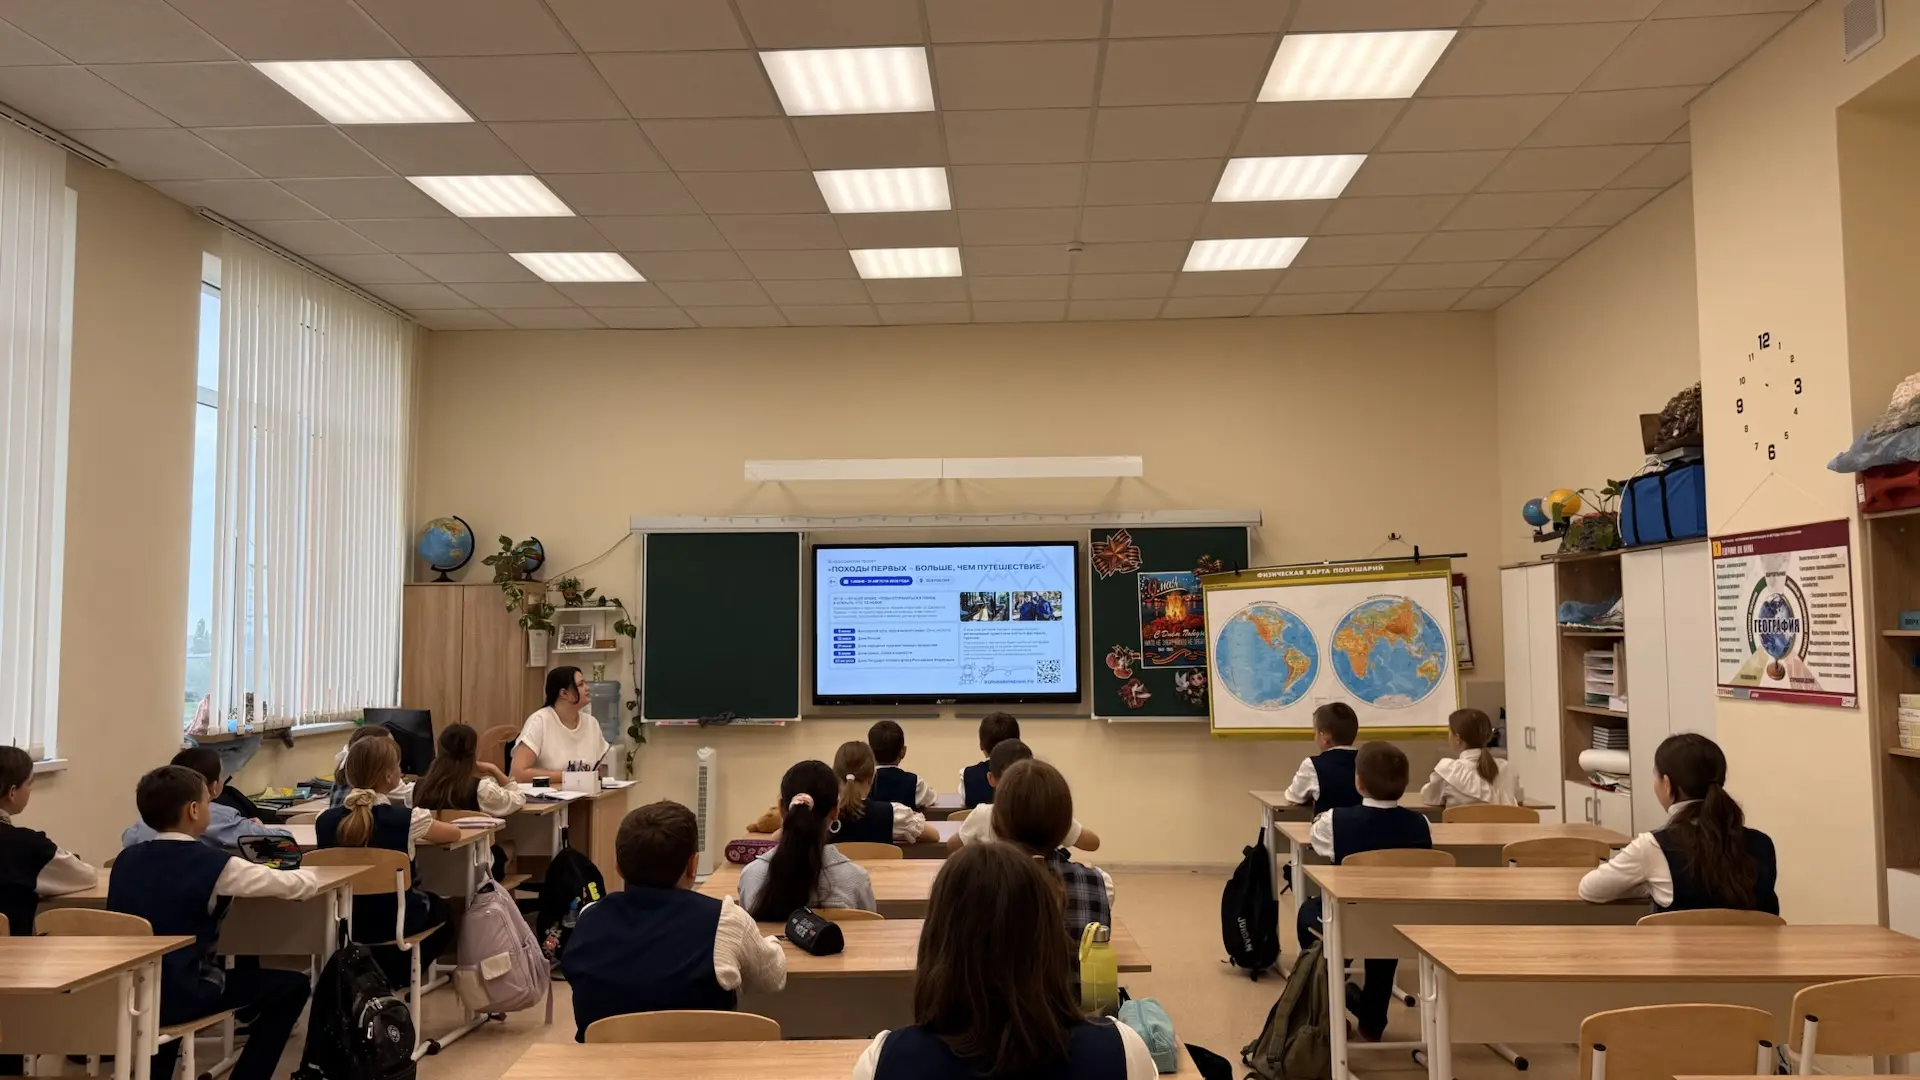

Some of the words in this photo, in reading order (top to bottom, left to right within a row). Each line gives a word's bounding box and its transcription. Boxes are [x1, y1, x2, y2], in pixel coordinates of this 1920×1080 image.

[1758, 332, 1770, 350] 12
[1778, 341, 1781, 350] 1
[1748, 353, 1754, 362] 11
[1790, 354, 1795, 363] 2
[1739, 376, 1746, 385] 10
[1794, 378, 1802, 395] 3
[1736, 398, 1743, 414] 9
[1793, 407, 1798, 415] 4
[1744, 424, 1749, 433] 8
[1784, 431, 1789, 440] 5
[1754, 442, 1759, 451] 7
[1768, 444, 1775, 460] 6
[915, 564, 955, 572] БОЛЬШЕ,
[1257, 570, 1304, 578] ФИЗИЧЕСКАЯ
[1306, 568, 1330, 576] КАРТА
[1333, 565, 1385, 574] ПОЛУШАРИЙ
[1754, 619, 1800, 633] ГЕОГРАФИЯ
[1154, 630, 1160, 639] С
